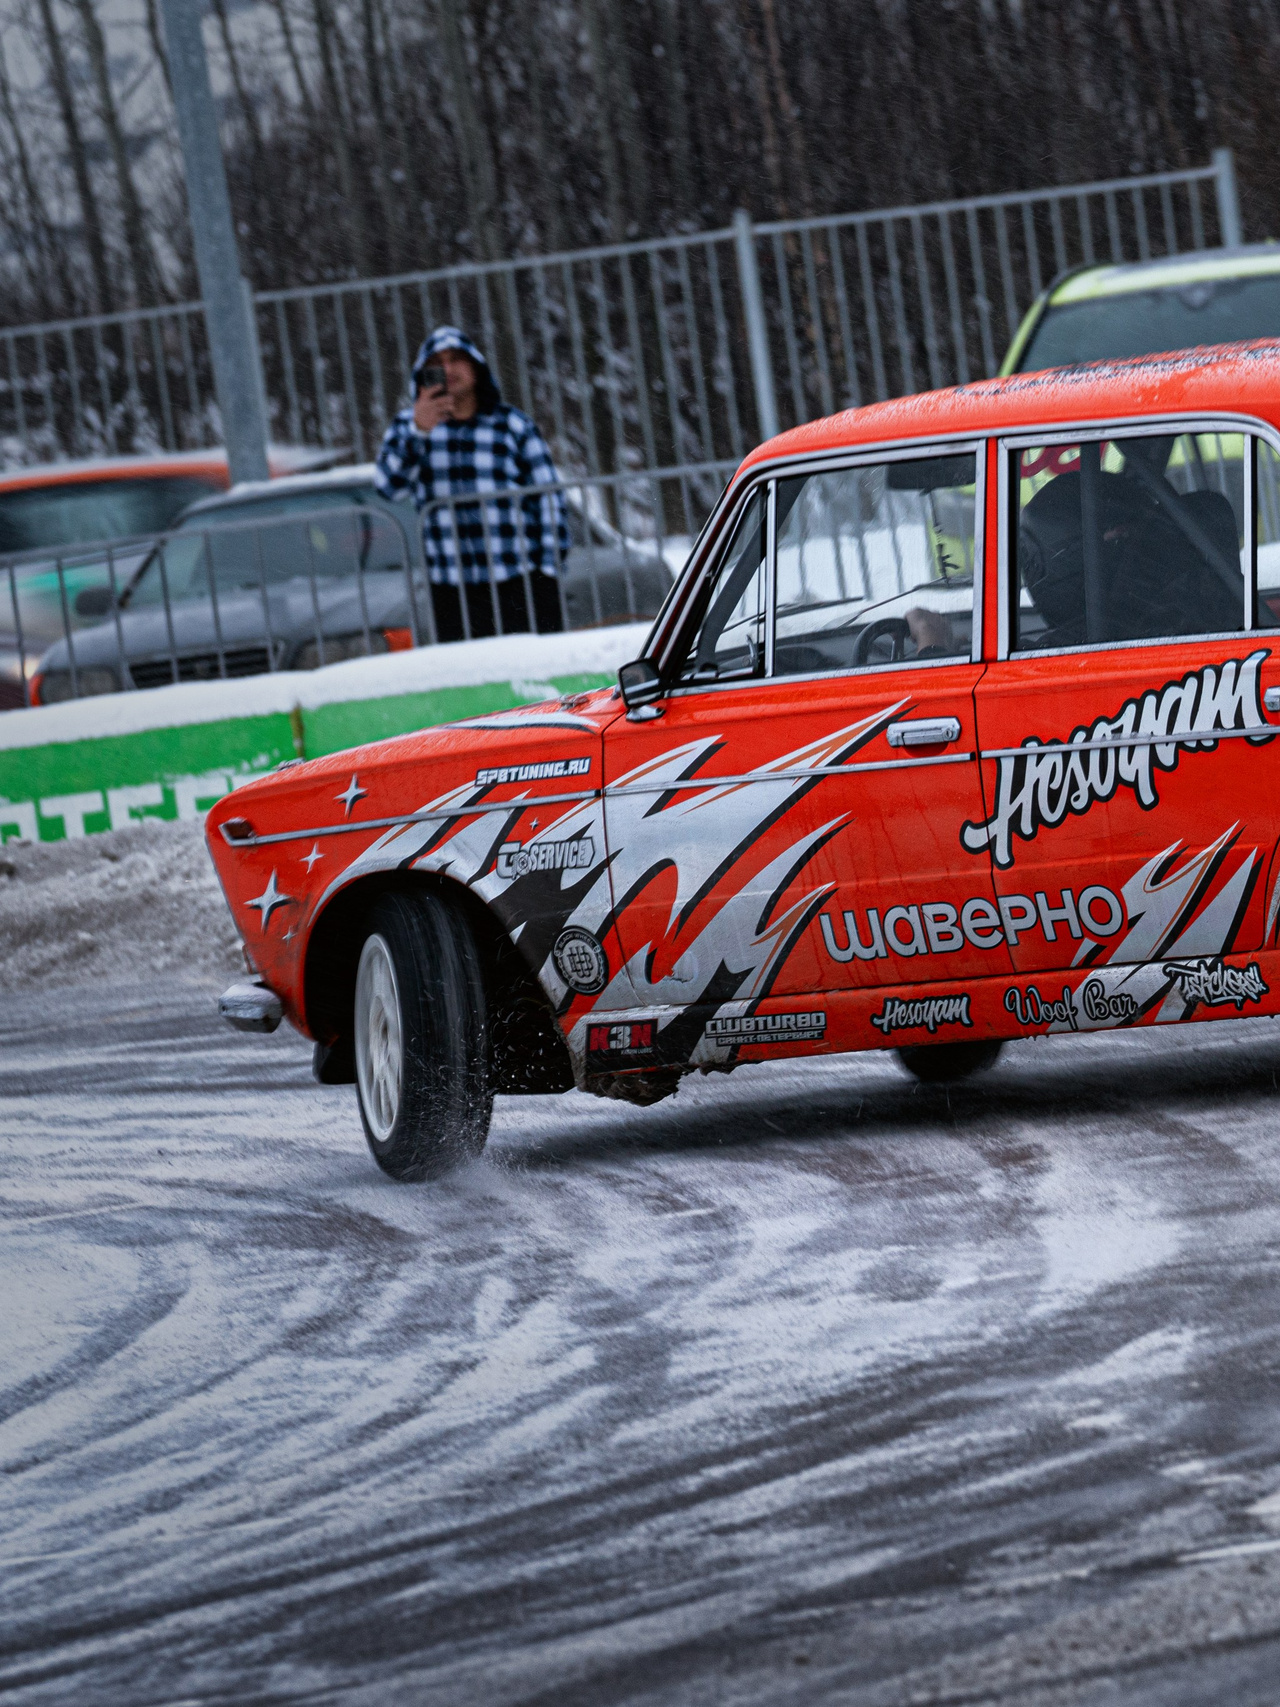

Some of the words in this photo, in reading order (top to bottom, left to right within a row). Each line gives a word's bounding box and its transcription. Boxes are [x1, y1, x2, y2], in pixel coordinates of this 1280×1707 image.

[476, 757, 591, 785] SPBTUNING.RU
[1005, 986, 1077, 1031] Woof
[1084, 980, 1137, 1019] Bar
[589, 1023, 652, 1051] K3N
[705, 1012, 826, 1034] CLUBTURBO
